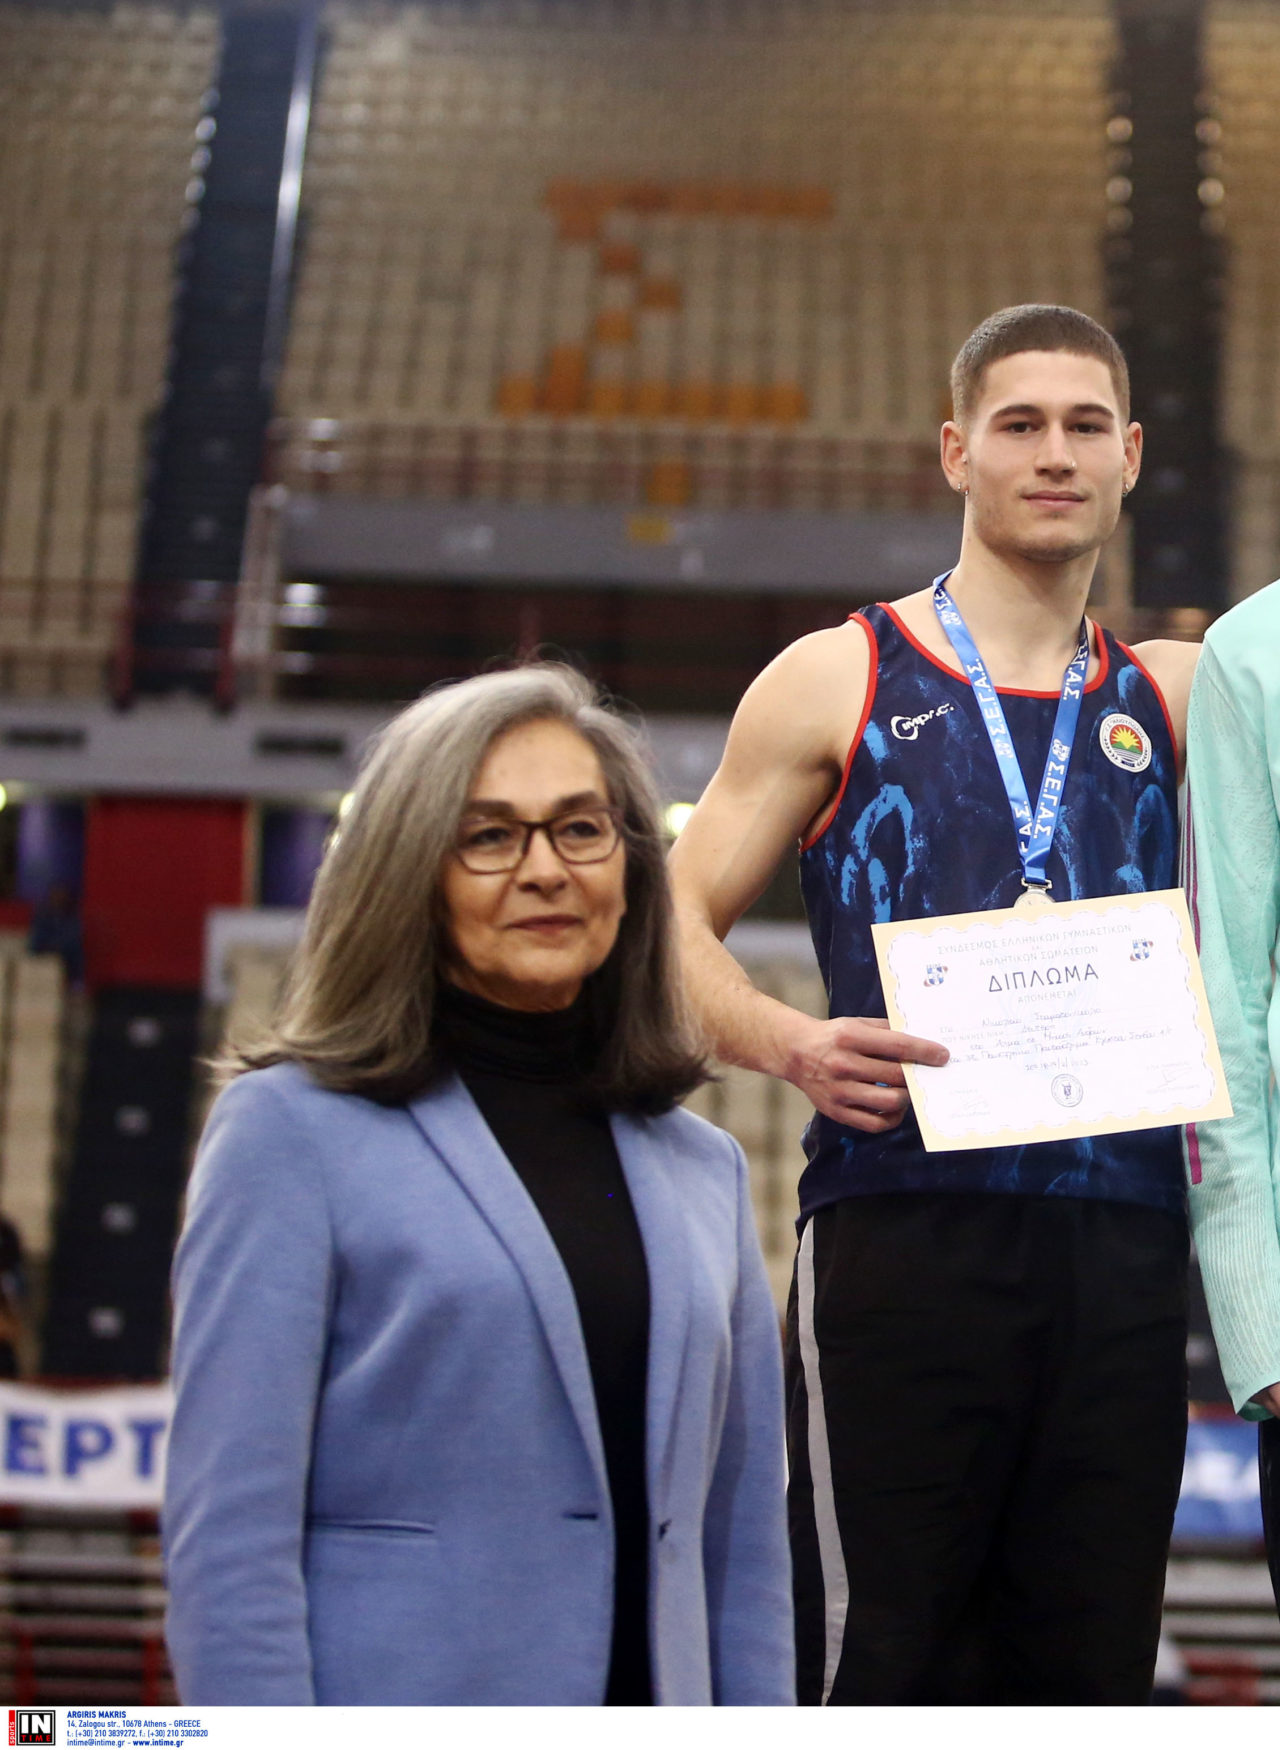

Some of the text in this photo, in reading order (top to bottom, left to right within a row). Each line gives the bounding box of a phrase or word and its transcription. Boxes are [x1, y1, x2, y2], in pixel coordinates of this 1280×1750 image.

[966, 657, 1007, 737] Σ.Ε.Γ.Α.Σ.
[1033, 762, 1065, 838] Σ.Ε.Γ.Α.Σ.
[937, 924, 1132, 955] ΣΥΝΔΕΣΜΟΣ ΕΛΛΗΝΙΚΩΝ ΓΥΜΝΑΣΤΙΚΩΝ
[979, 945, 1099, 967] ΑΘΛΗΤΙΚΩΝ ΣΩΜΑΤΕΙΩΝ
[988, 962, 1099, 993] ΔΙΠΛΩΜΑ
